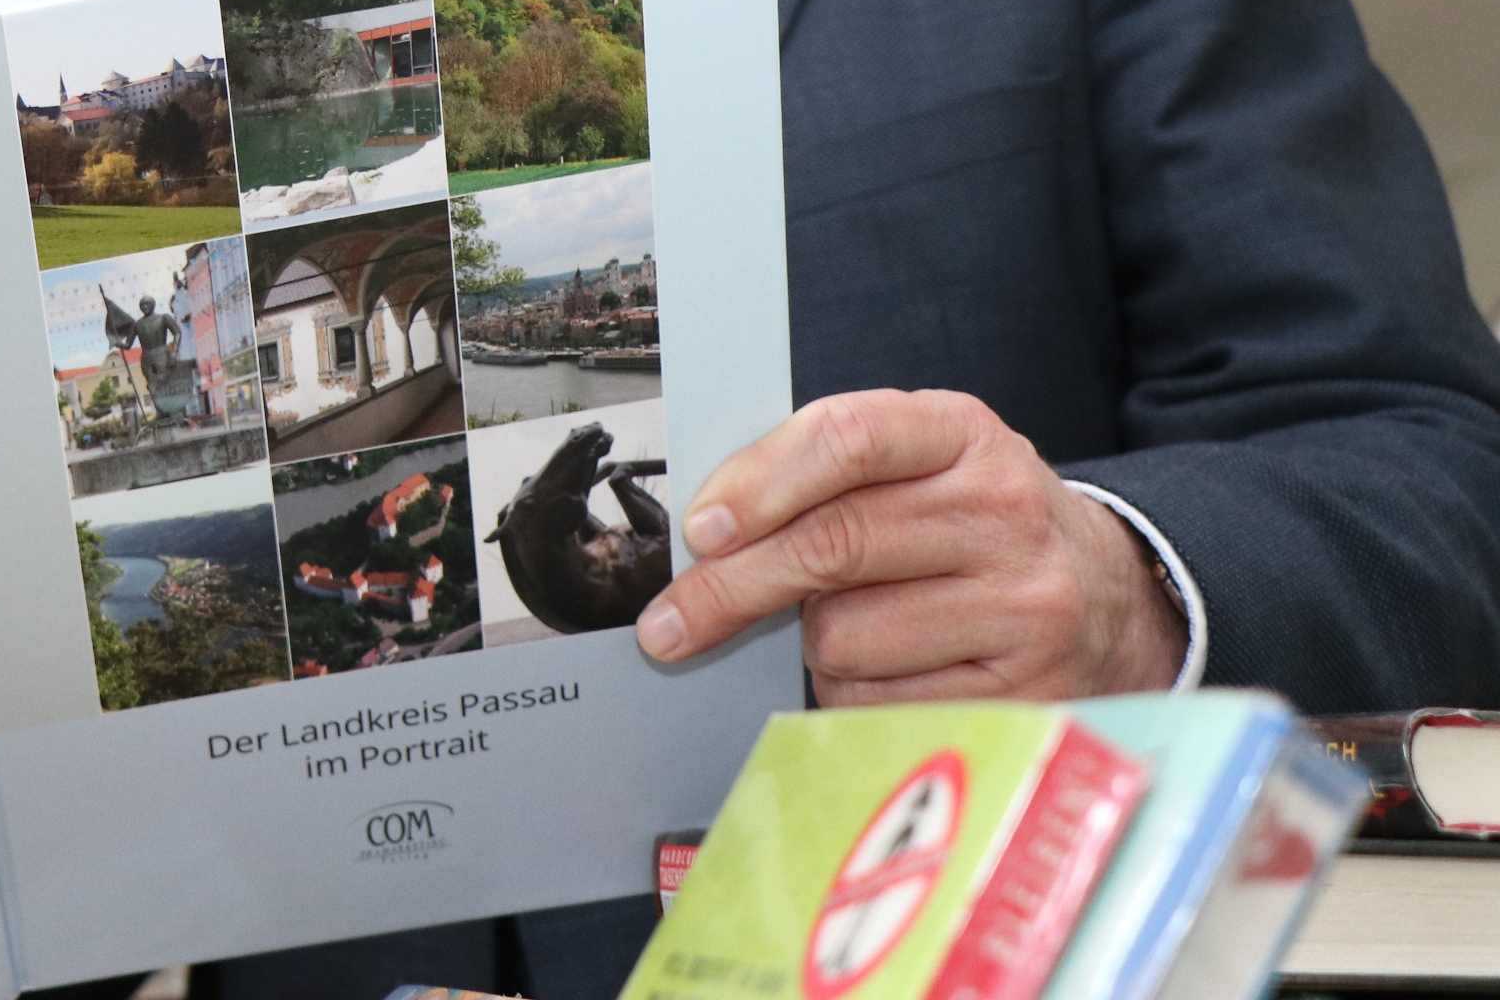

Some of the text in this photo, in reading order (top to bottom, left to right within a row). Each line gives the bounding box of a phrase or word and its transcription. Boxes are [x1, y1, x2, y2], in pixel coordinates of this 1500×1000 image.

[207, 682, 580, 760] Der Landkreis Passau
[305, 729, 491, 780] im Portrait
[366, 808, 435, 847] COM
